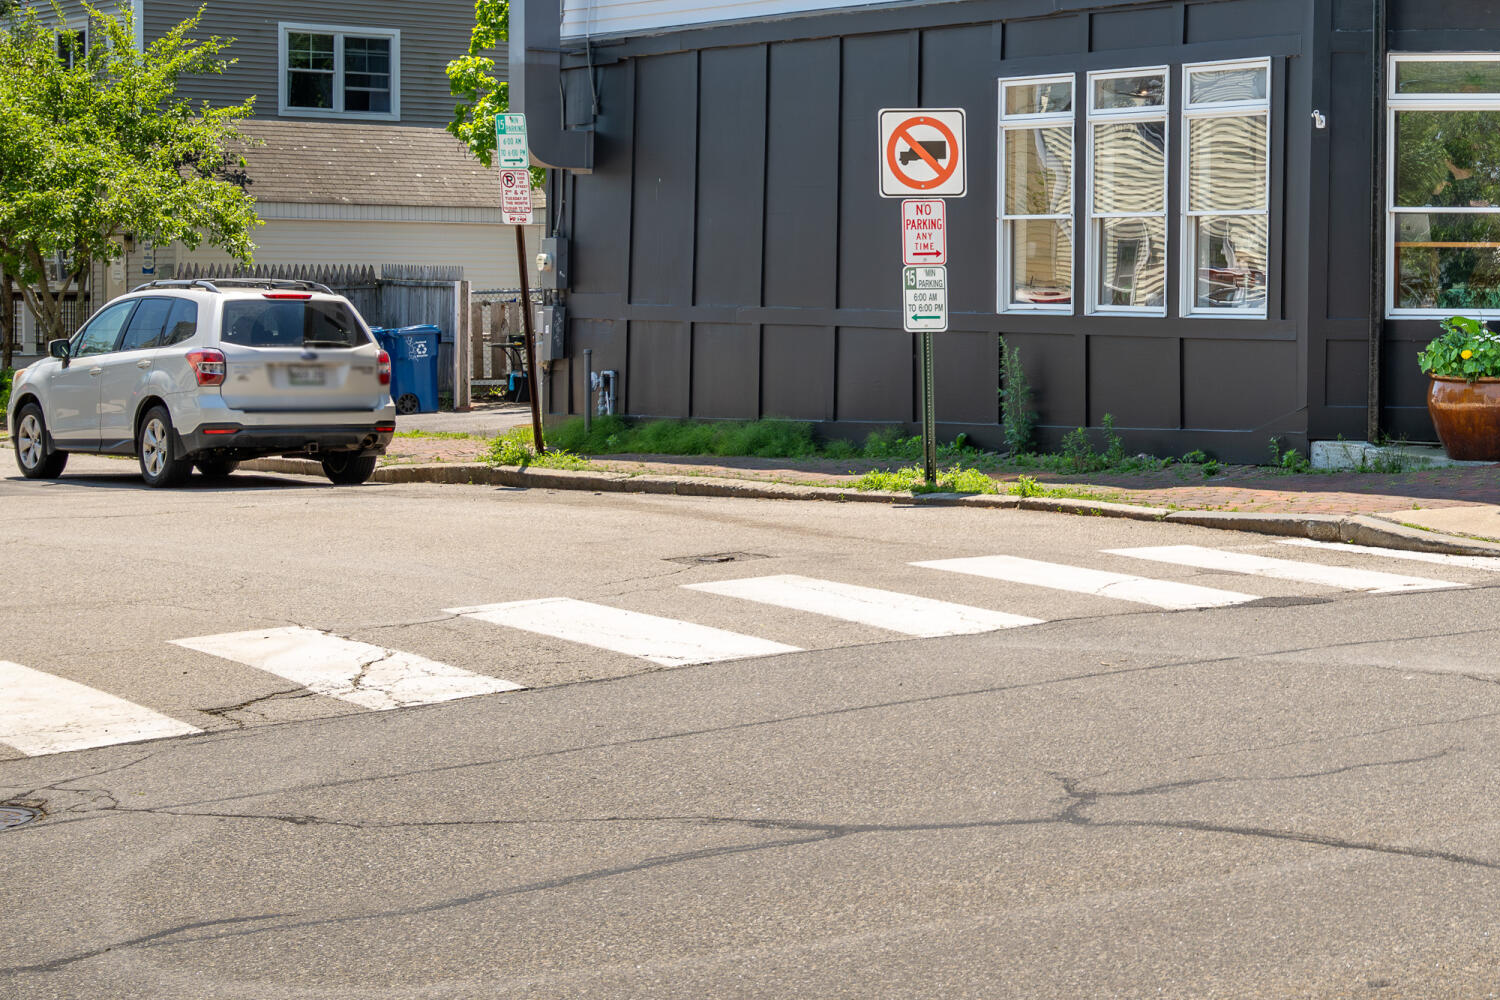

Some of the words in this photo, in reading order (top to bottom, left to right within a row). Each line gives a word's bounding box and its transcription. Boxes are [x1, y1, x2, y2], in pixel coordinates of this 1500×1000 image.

[497, 119, 505, 130] 15
[915, 204, 932, 216] NO
[905, 218, 943, 231] PARKING
[915, 232, 933, 241] ANY
[914, 242, 935, 251] TIME
[924, 268, 936, 278] MIN
[905, 269, 916, 287] 15
[918, 279, 944, 288] PARKING
[913, 293, 927, 302] 6:00
[928, 293, 938, 302] AM
[908, 303, 917, 312] TO
[918, 303, 933, 312] 6:00
[934, 303, 944, 312] PM
